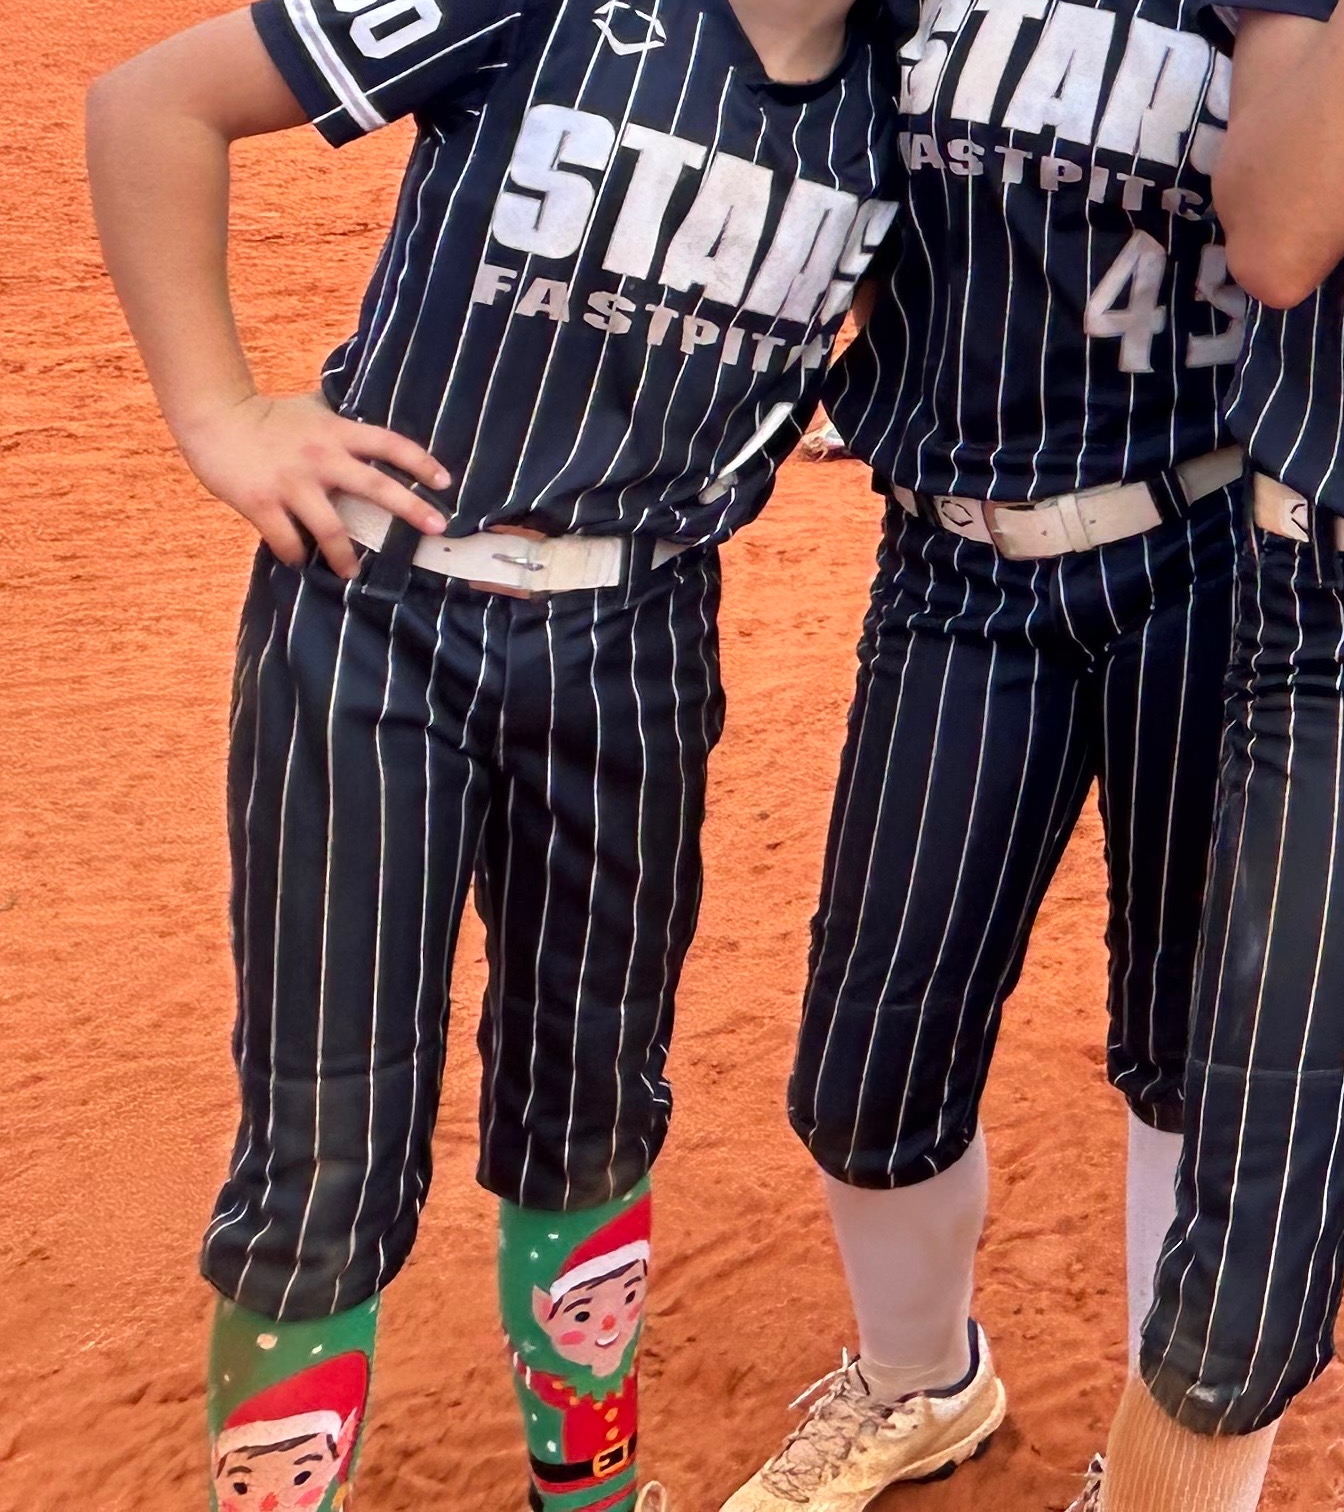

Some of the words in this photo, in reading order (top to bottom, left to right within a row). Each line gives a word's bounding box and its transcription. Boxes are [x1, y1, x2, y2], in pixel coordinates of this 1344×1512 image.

[492, 103, 899, 326] STARS
[900, 131, 1204, 221] ASTPITC
[472, 262, 834, 374] FASTPIT
[1083, 228, 1247, 373] 45
